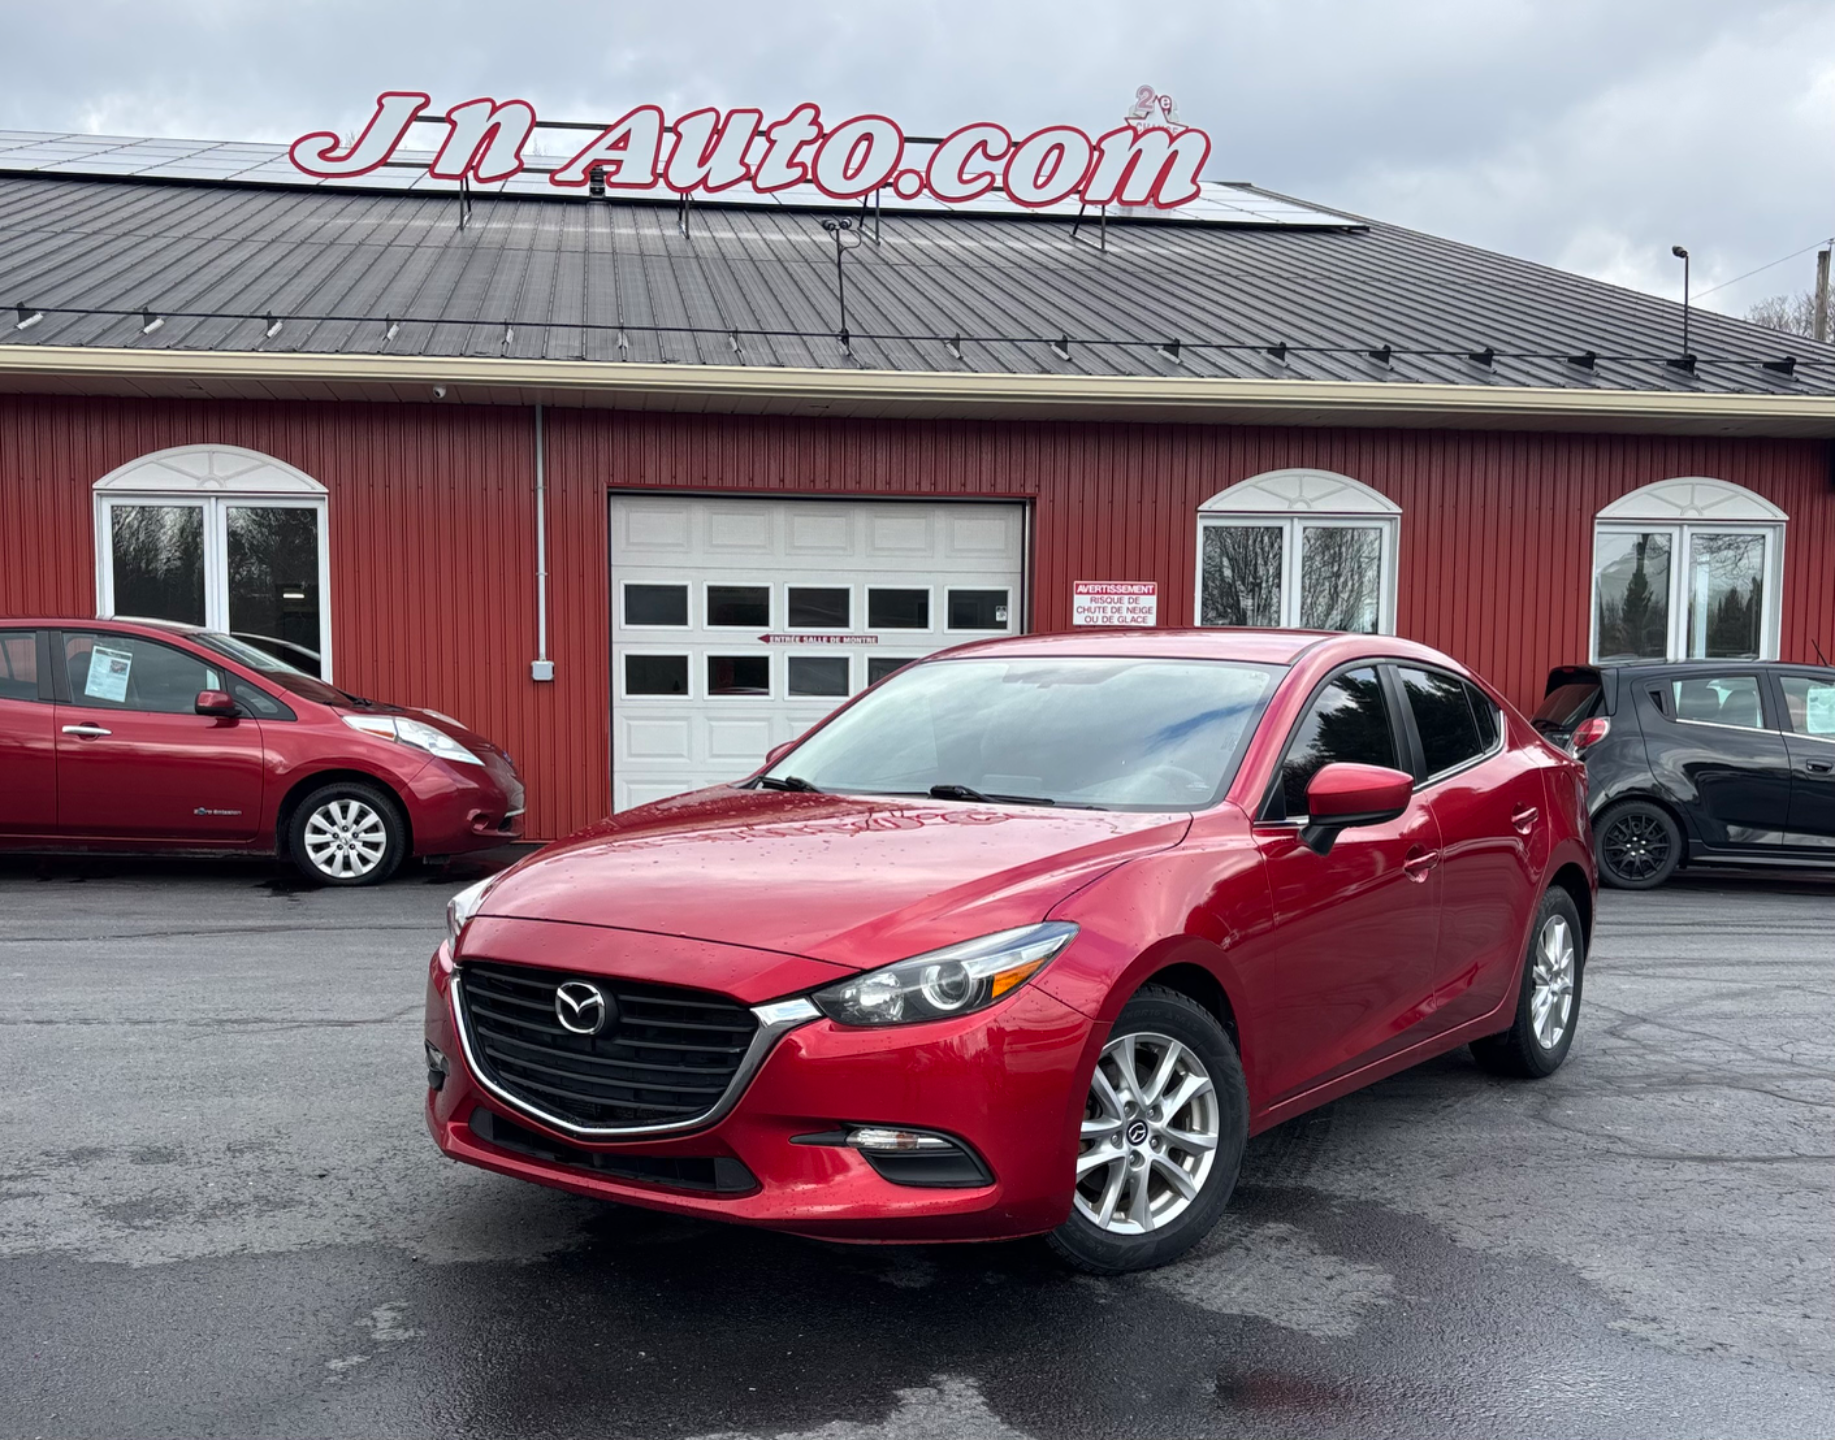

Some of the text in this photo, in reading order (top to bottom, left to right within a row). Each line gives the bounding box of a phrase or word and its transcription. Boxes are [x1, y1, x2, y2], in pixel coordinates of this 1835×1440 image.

[289, 91, 1211, 210] Jn Auto.com
[1076, 585, 1154, 594] AVERTISSEMENT
[1089, 596, 1141, 605] RISQUE DE
[1076, 605, 1154, 615] CHUTE DE NEIGE
[1084, 615, 1148, 624] OU DE GLACE
[803, 636, 828, 644] SALLE
[830, 636, 840, 644] DE
[843, 636, 877, 644] MONTRE
